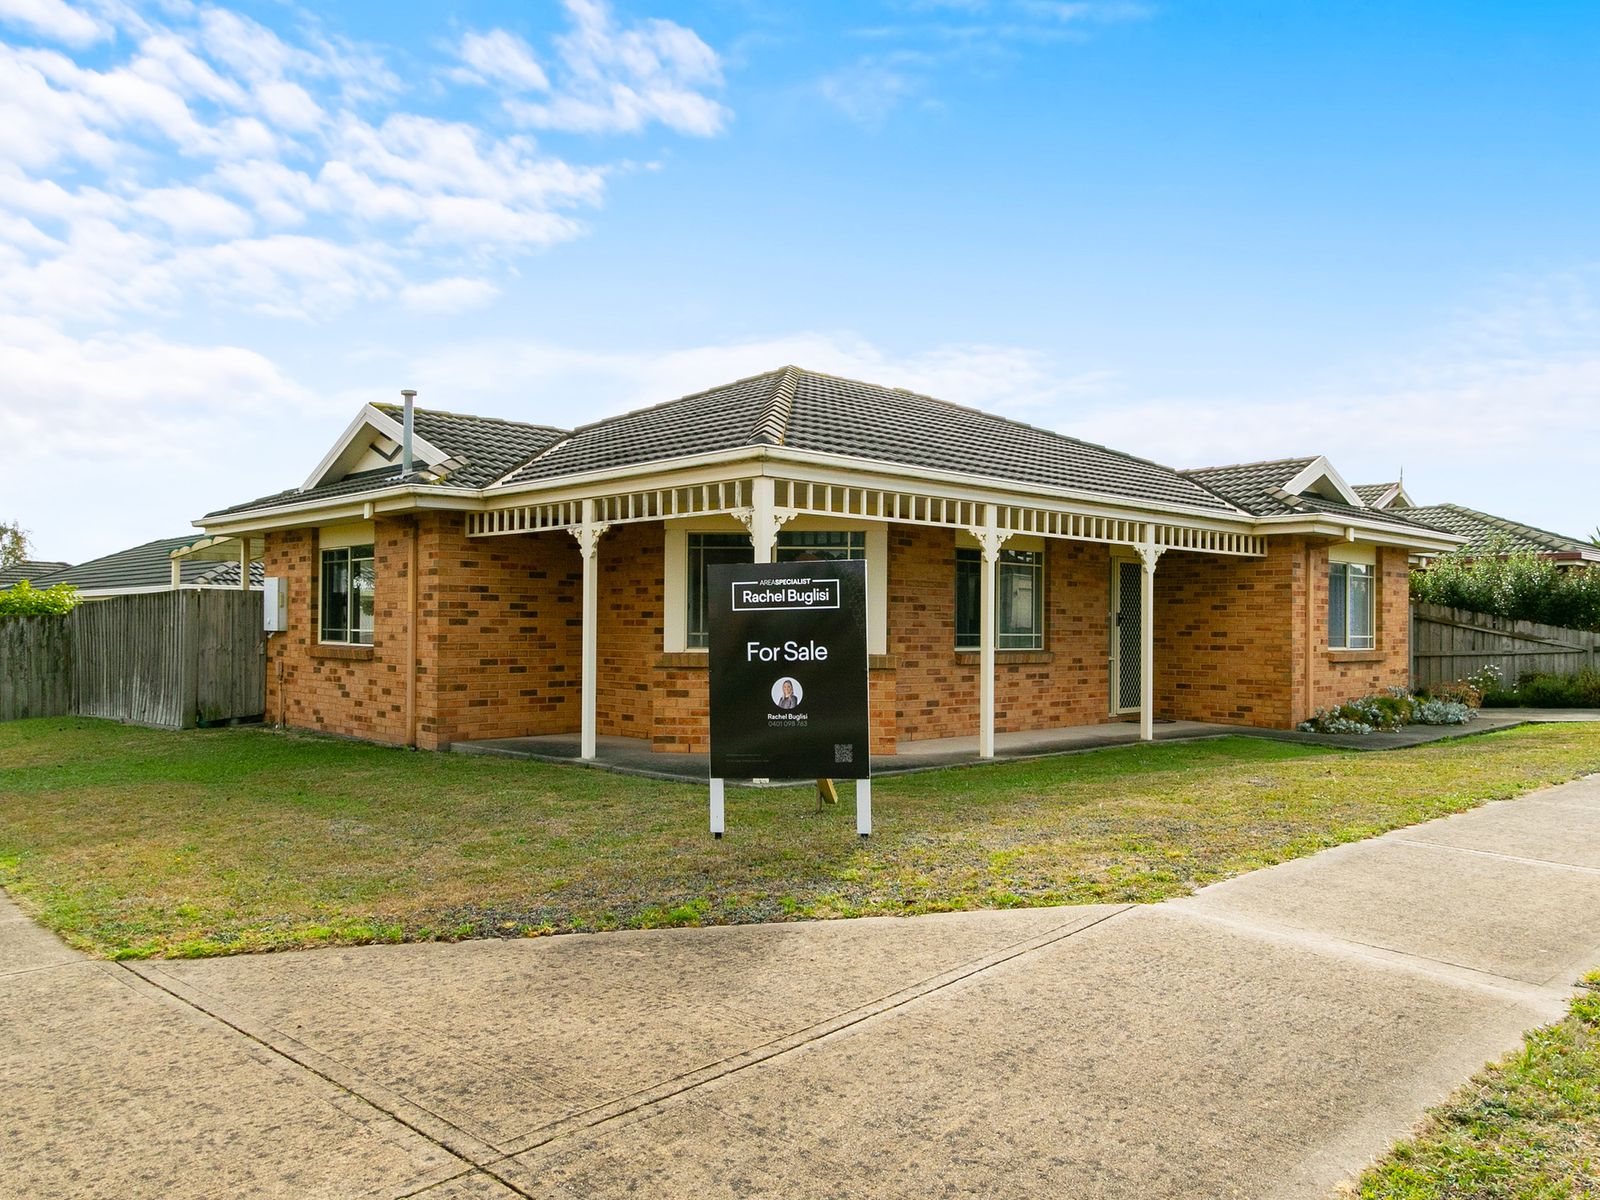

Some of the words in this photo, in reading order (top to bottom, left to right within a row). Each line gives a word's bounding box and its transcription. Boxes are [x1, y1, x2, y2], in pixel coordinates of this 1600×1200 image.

[760, 578, 811, 586] AREASPECIALIST
[743, 589, 785, 603] Rachel
[787, 588, 829, 605] Buglisi
[747, 642, 780, 661] For
[784, 640, 828, 661] Sale
[788, 713, 808, 721] Buglisi
